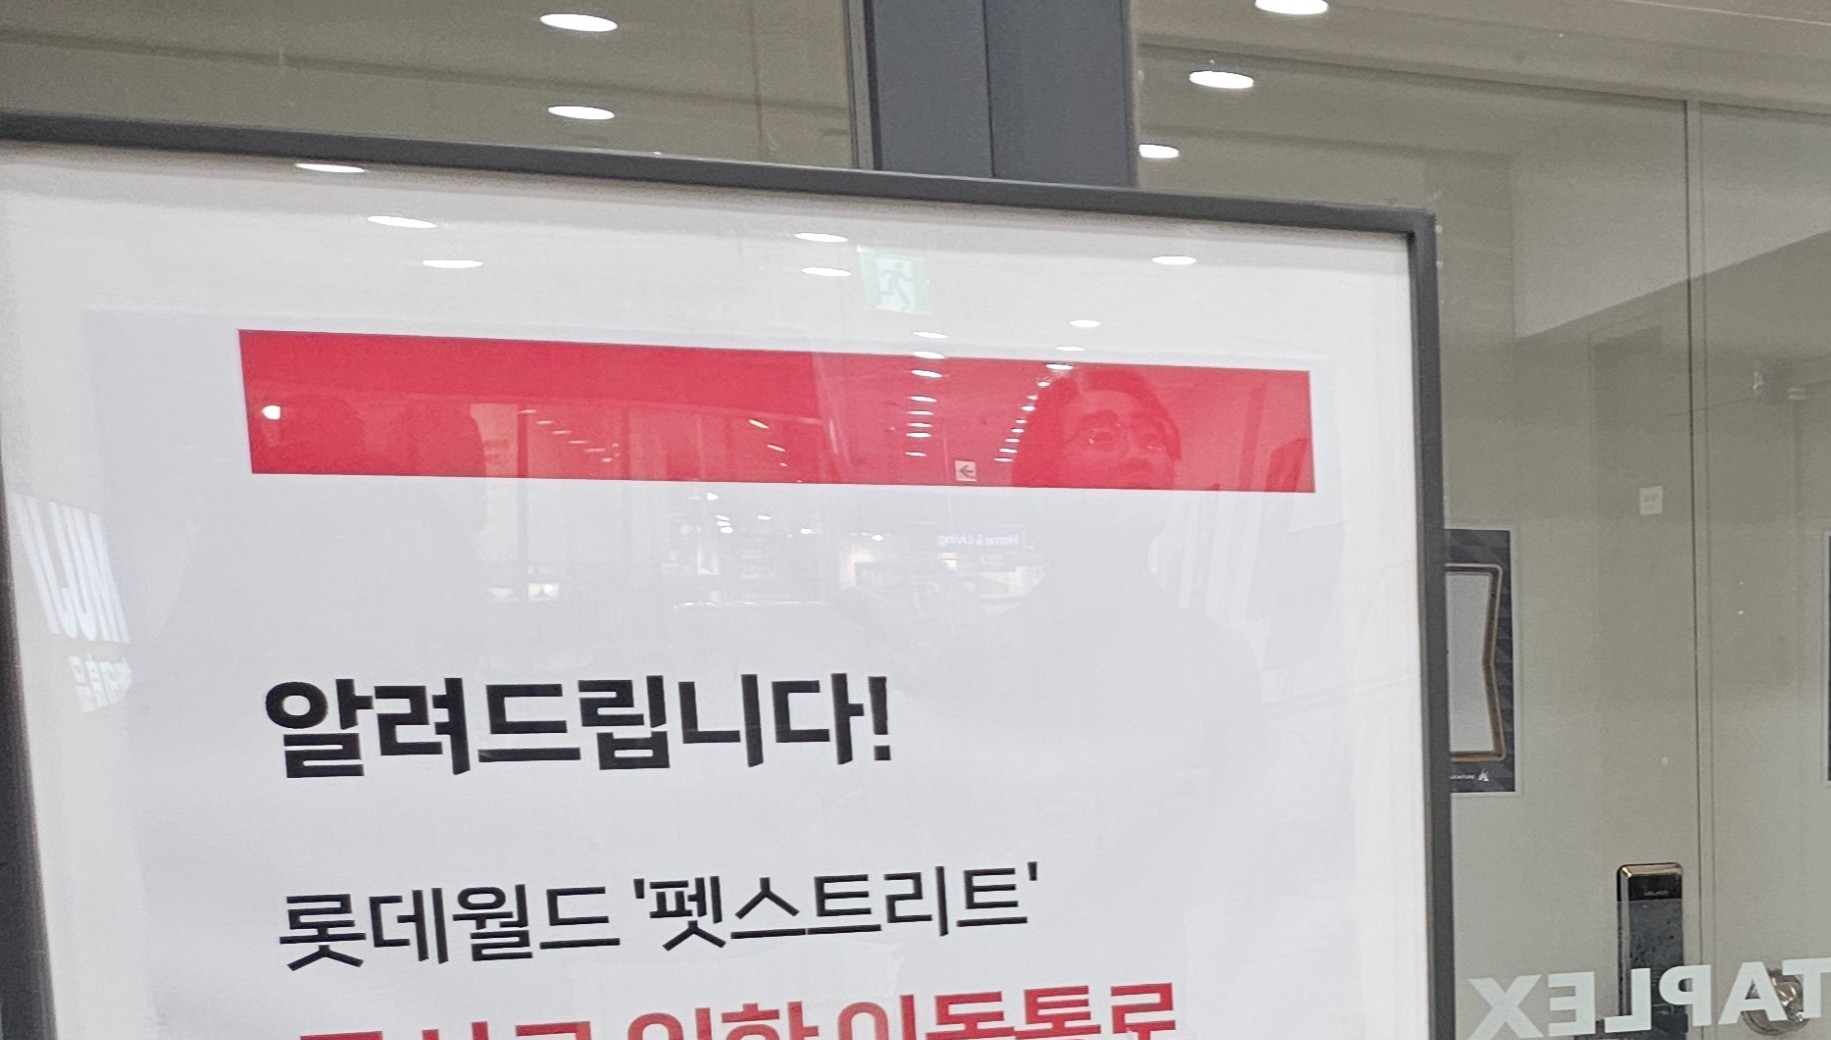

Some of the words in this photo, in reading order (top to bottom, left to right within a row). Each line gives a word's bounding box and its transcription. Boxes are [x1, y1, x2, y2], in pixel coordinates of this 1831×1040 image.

[265, 673, 891, 778] 알려드립니다!
[280, 884, 620, 971] 롯데월드
[634, 862, 1037, 951] '펫스트리트'
